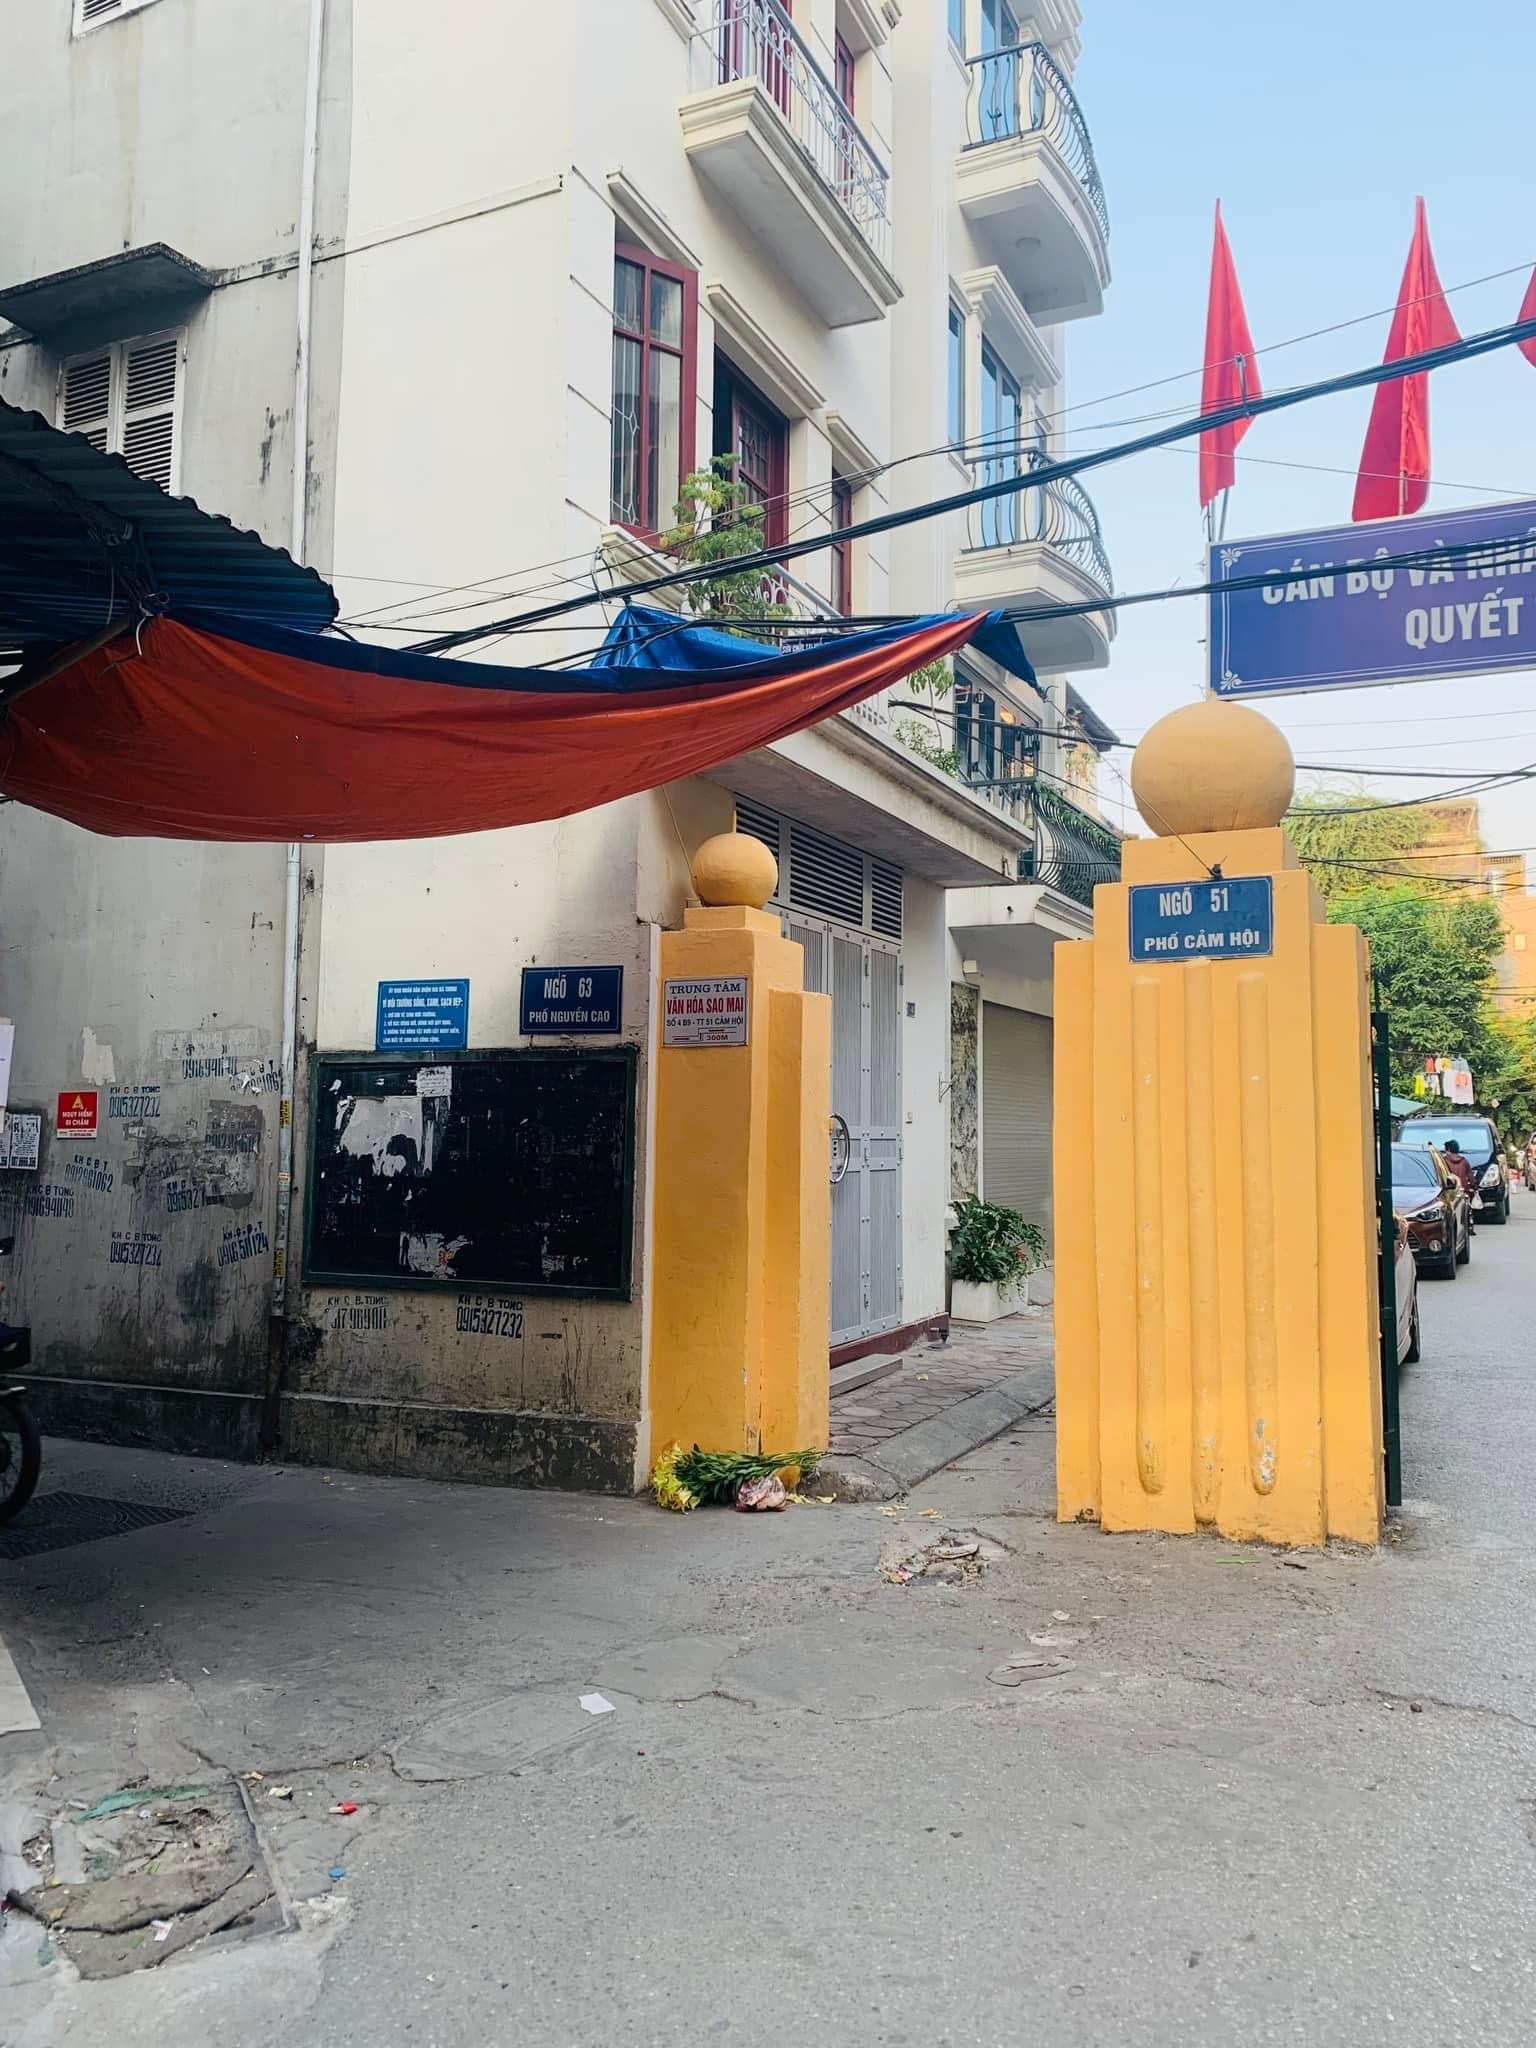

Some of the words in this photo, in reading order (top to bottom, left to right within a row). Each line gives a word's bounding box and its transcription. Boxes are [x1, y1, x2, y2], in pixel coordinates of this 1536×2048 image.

[1262, 558, 1334, 605] CÁN
[1346, 546, 1395, 600] BỘ
[1405, 586, 1524, 649] QUYẾT
[1159, 887, 1193, 917] NGÕ
[1210, 887, 1229, 913] 51
[1144, 931, 1179, 952] PHỐ
[1184, 929, 1224, 949] CẢM
[1230, 929, 1260, 949] HỘI
[543, 974, 567, 999] NGÕ
[578, 977, 593, 998] 63
[669, 984, 711, 995] TRUNG
[713, 980, 741, 993] TÂM
[529, 1007, 548, 1023] PHỐ
[591, 1010, 610, 1023] CAO
[667, 996, 685, 1015] VĂN
[706, 997, 724, 1013] SAO
[726, 996, 744, 1013] MAI
[456, 1306, 523, 1338] 0915327232
